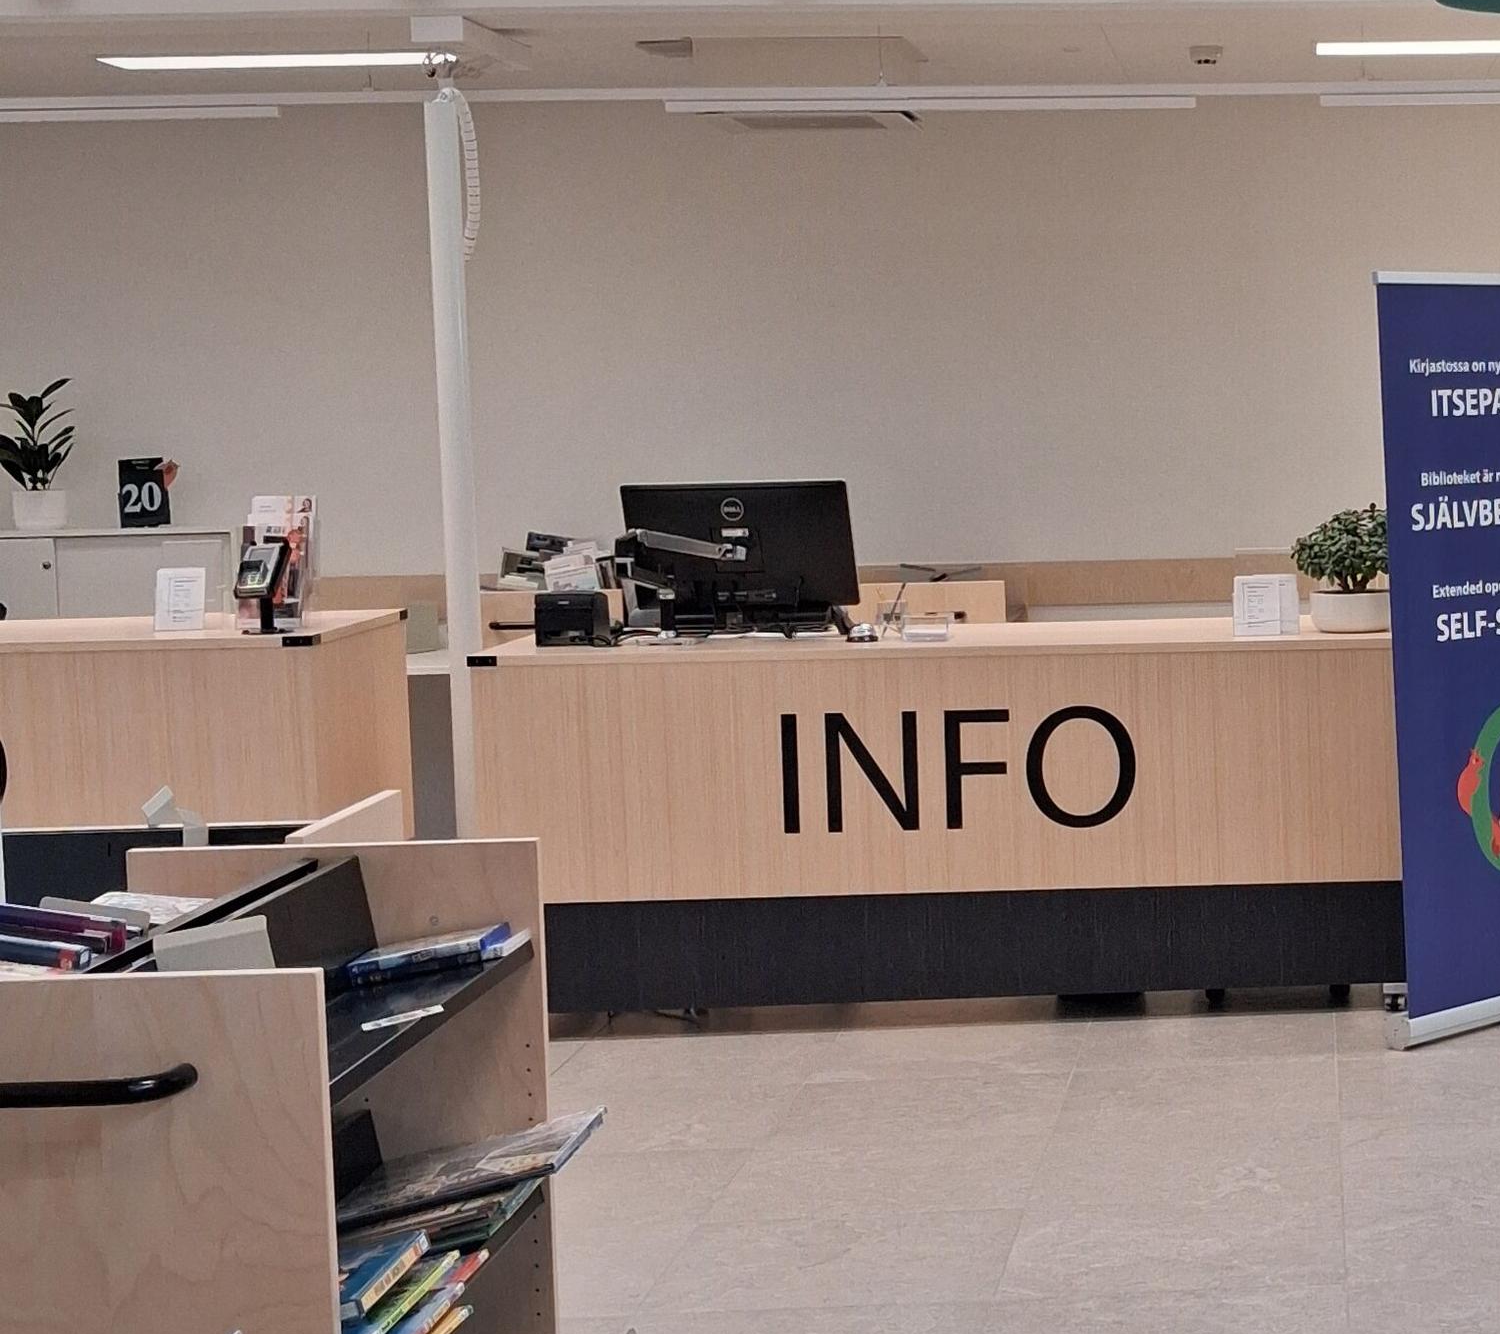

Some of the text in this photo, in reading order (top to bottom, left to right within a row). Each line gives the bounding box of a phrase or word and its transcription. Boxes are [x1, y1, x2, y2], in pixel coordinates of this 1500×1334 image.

[1409, 358, 1469, 376] Kirjastossa
[1473, 361, 1486, 373] on
[1420, 470, 1481, 487] Biblioteket
[1482, 469, 1493, 483] är
[122, 481, 162, 513] 20
[1432, 580, 1483, 598] Extended
[780, 705, 1136, 834] INFO
